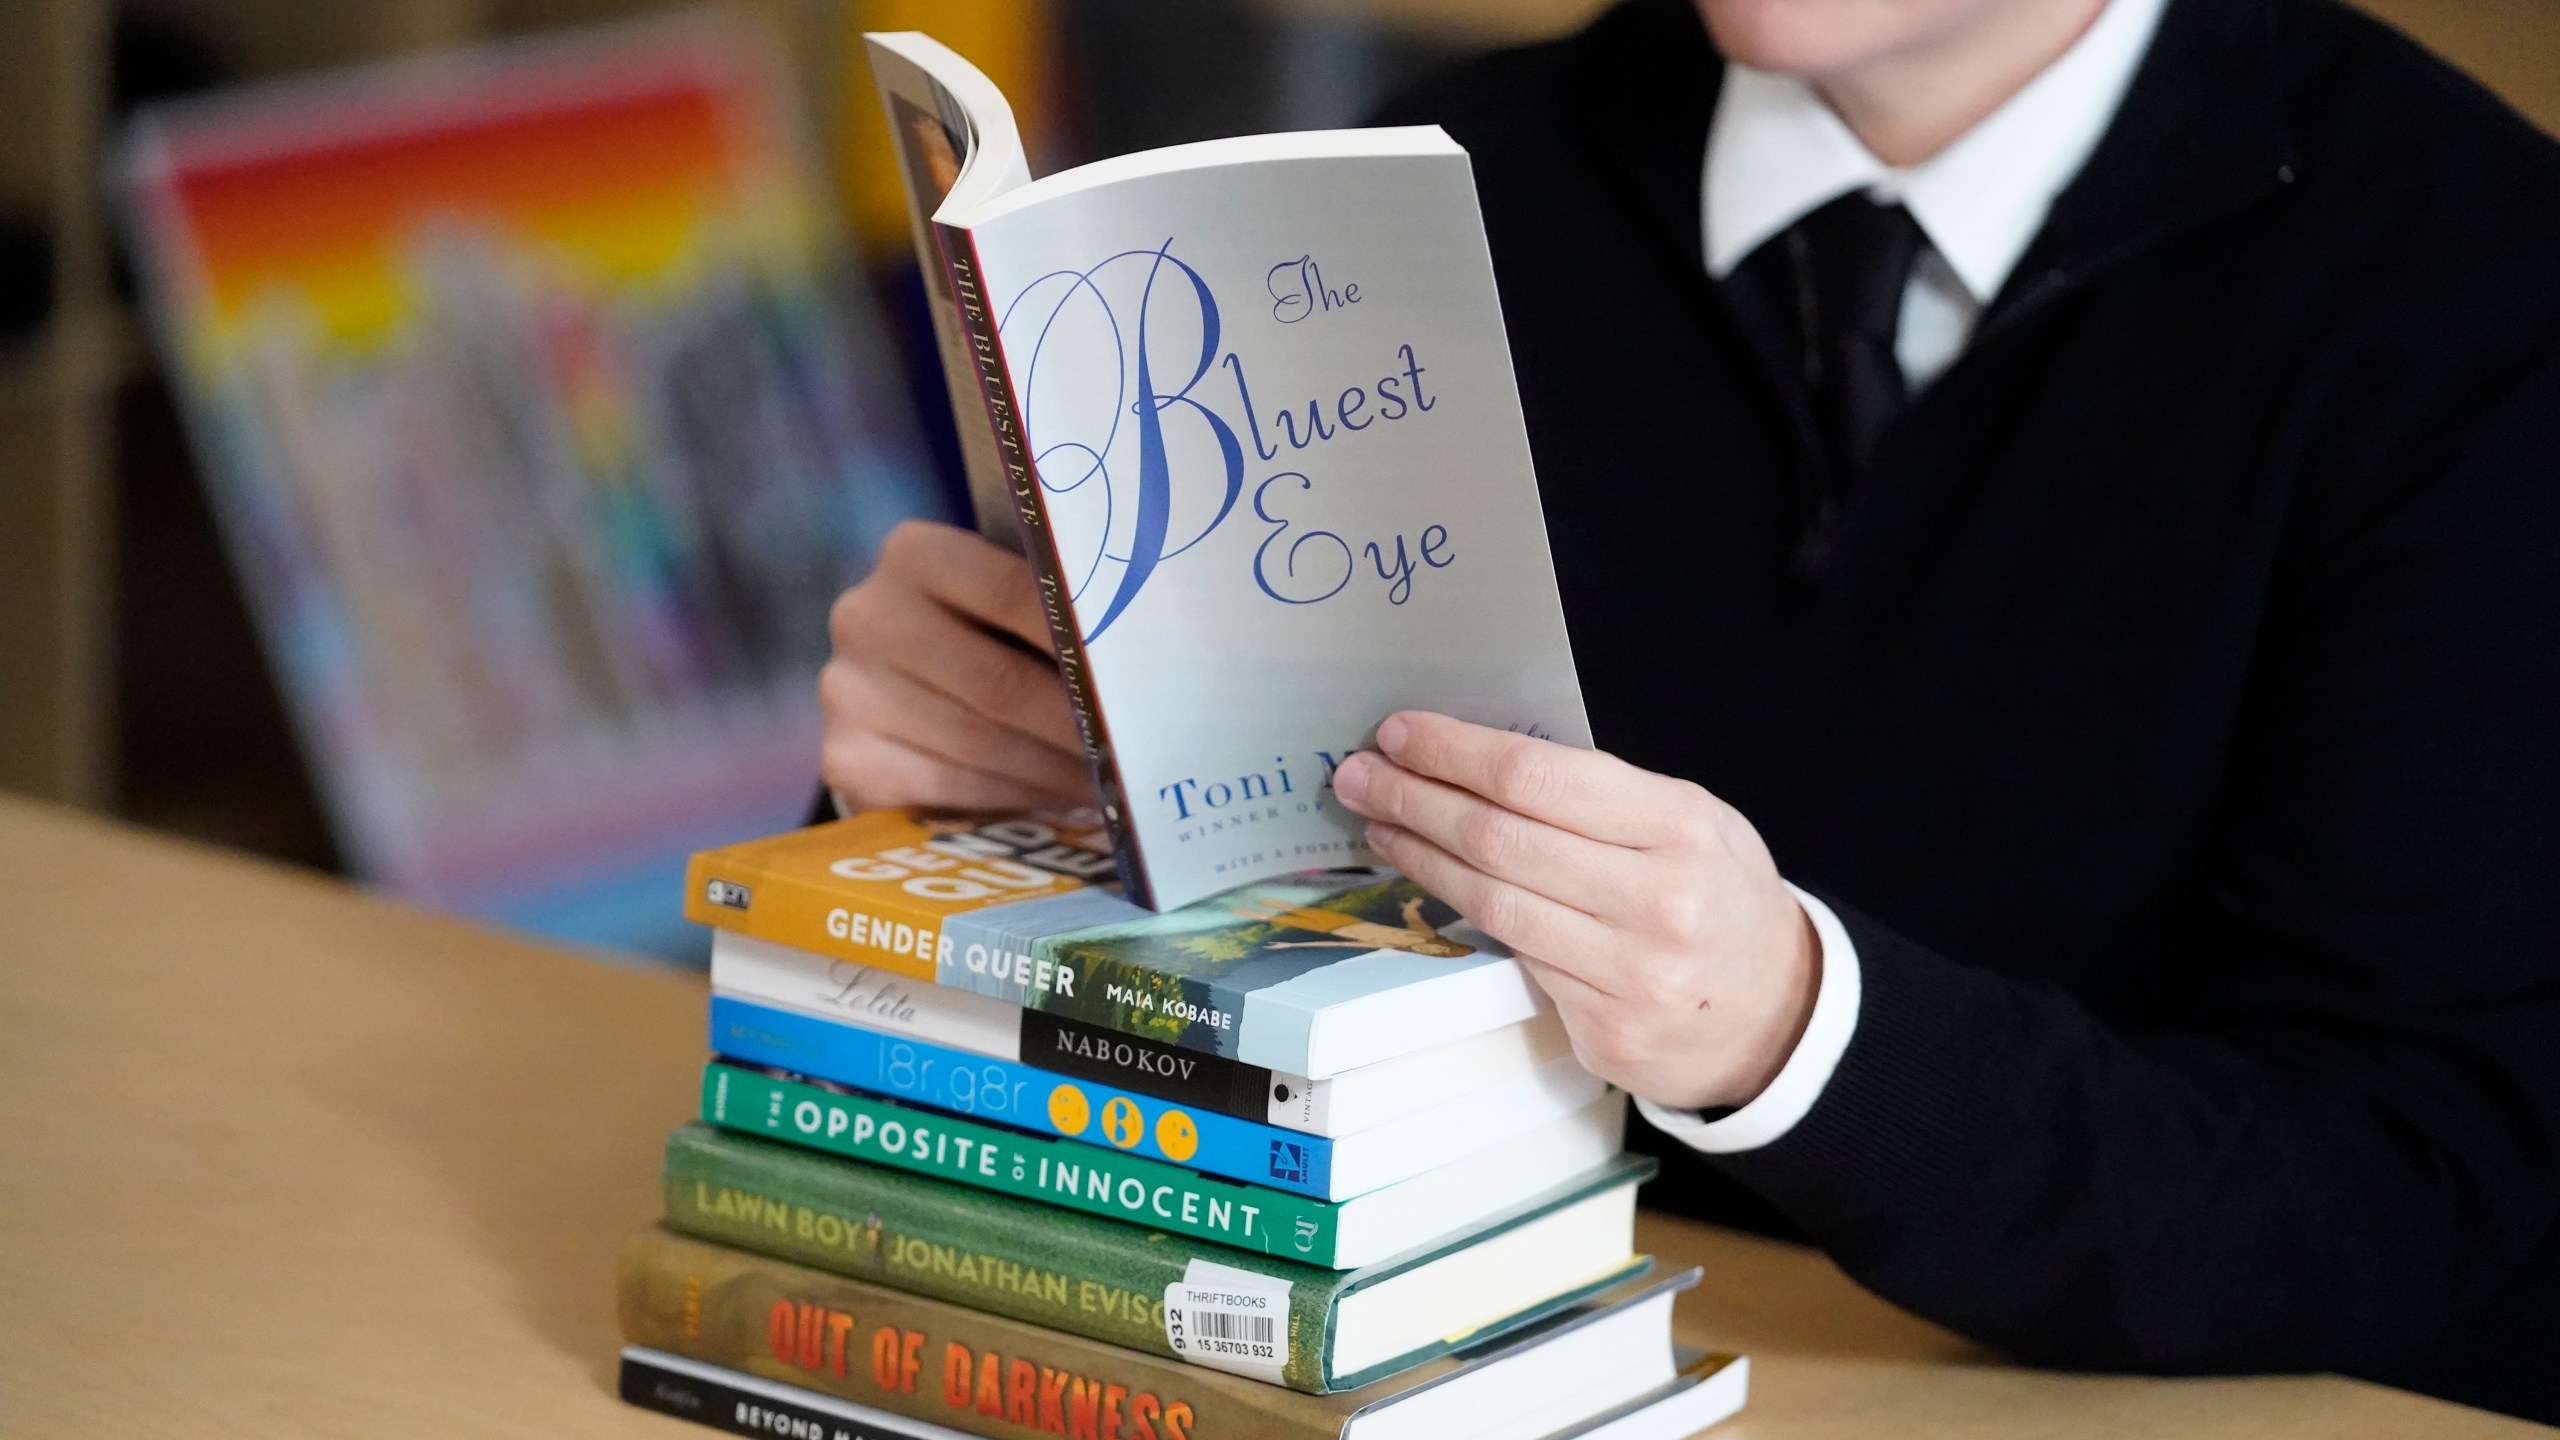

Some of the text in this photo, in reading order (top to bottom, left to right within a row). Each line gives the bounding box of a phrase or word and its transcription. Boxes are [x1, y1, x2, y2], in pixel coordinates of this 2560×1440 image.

[1267, 253, 1363, 324] The
[953, 257, 1040, 528] THE BLUEST EYE
[998, 236, 1436, 647] Bluest
[1253, 471, 1456, 606] Eye
[1040, 573, 1099, 761] Toni Morrison
[1159, 755, 1294, 822] Toni
[829, 820, 1058, 881] GEND
[1178, 806, 1280, 844] WINNER
[826, 907, 1232, 1031] GENDER QUEER MAIA KOBABE
[816, 957, 1196, 1081] Lolita NABOKOV
[1303, 1079, 1314, 1123] VINTAG
[793, 1100, 999, 1177] OPPOSITE
[1012, 1151, 1027, 1182] OF
[1038, 1157, 1260, 1237] INNOCENT
[1302, 1147, 1310, 1185] AMULET
[696, 1183, 1166, 1331] LAWN BOY JONATHAN EVISO
[1169, 1307, 1187, 1350] 932
[1186, 1290, 1267, 1309] THRIFTBOOKS
[769, 1299, 855, 1379] OUT
[872, 1326, 926, 1396] OF
[944, 1341, 1194, 1440] DARKNESS
[1197, 1339, 1274, 1359] 15 36703 932
[1289, 1313, 1301, 1380] CHAPEL HILL
[735, 1401, 824, 1440] BEYOND
